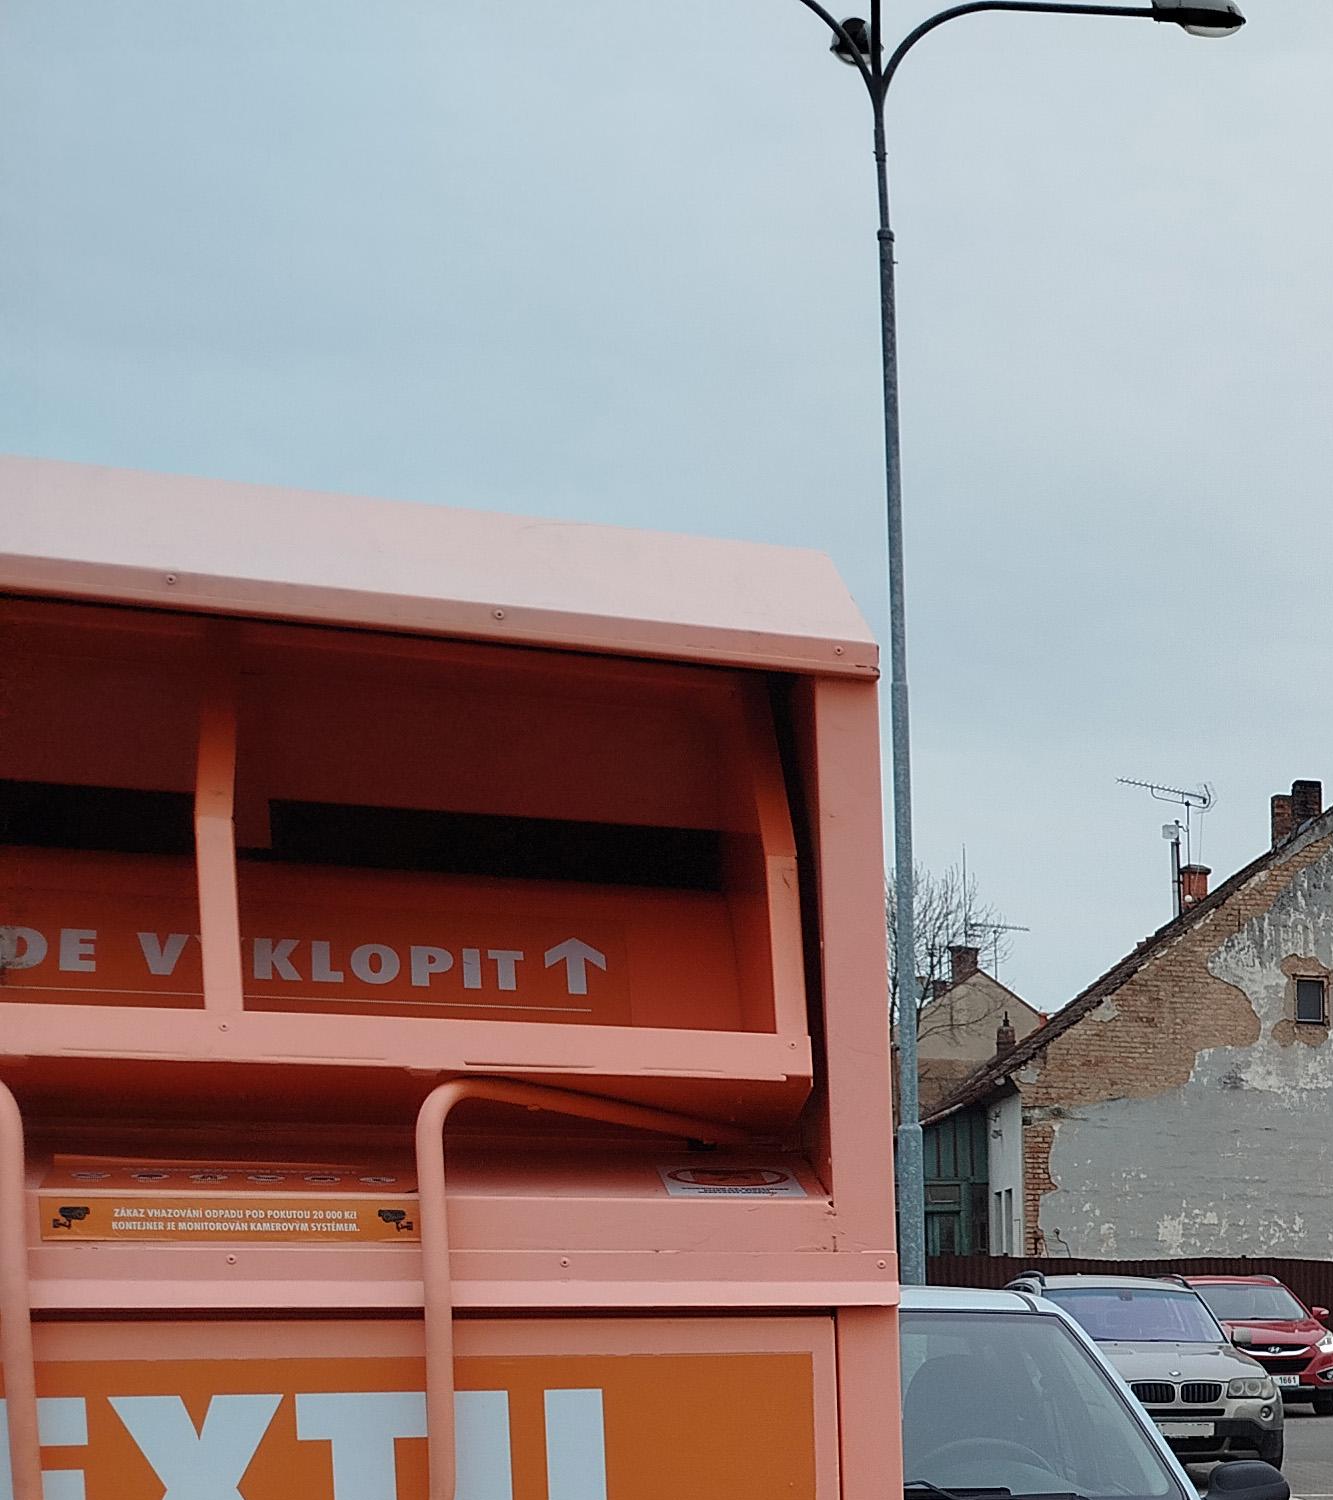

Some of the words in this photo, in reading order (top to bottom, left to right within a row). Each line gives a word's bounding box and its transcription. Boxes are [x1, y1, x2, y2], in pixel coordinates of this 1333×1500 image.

[137, 932, 525, 992] VKLOPIT
[205, 1209, 243, 1219] ODPADU
[246, 1210, 265, 1219] POD
[267, 1210, 311, 1219] POKUTOU
[313, 1211, 324, 1219] 20
[326, 1211, 343, 1220] 000
[112, 1221, 165, 1230] KONTEJNER
[166, 1221, 176, 1231] JE
